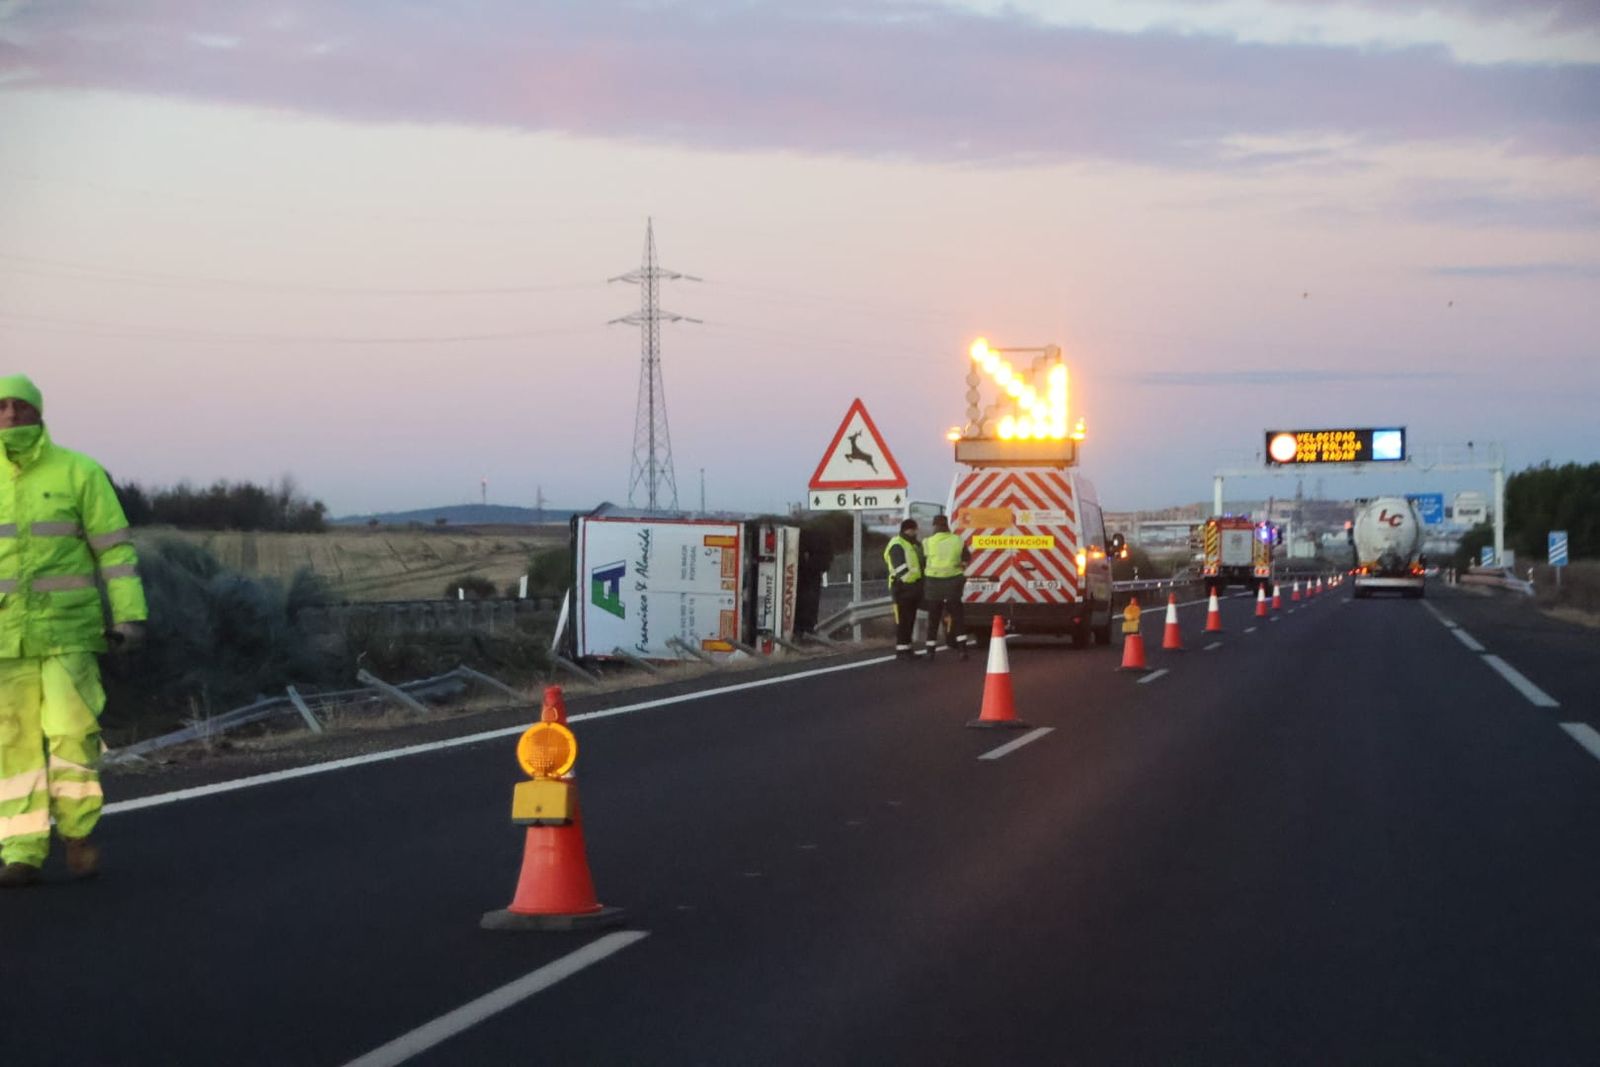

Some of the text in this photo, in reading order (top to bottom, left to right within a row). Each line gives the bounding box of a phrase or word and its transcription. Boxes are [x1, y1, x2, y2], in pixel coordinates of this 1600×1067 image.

[837, 493, 878, 506] 6 km
[1378, 508, 1404, 528] LC
[784, 562, 796, 632] SCANIA
